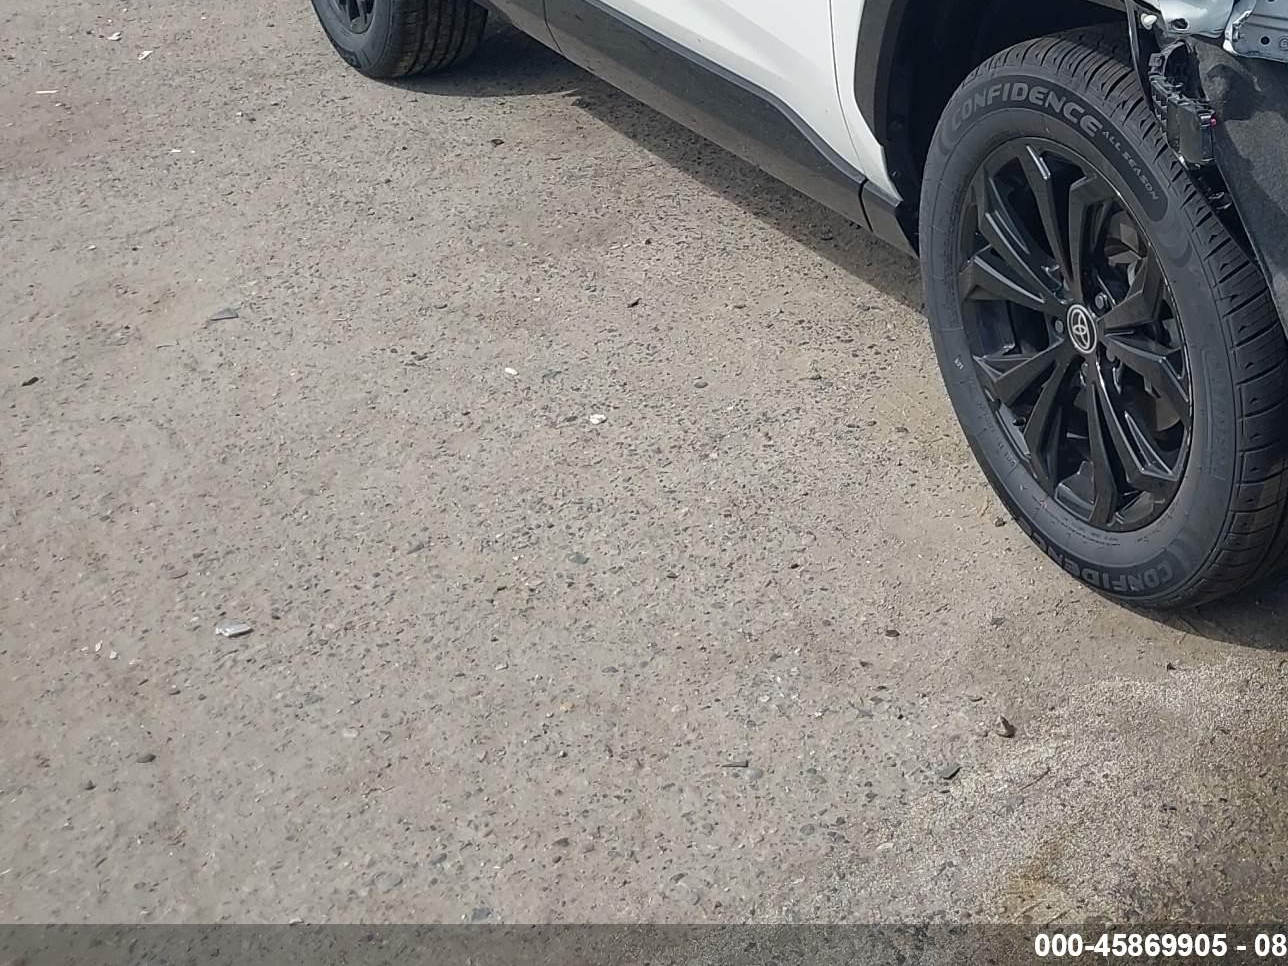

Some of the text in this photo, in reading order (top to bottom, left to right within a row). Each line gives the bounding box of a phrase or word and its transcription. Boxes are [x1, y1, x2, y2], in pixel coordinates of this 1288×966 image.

[951, 82, 1160, 200] CONFIDENCE ALL SEASON
